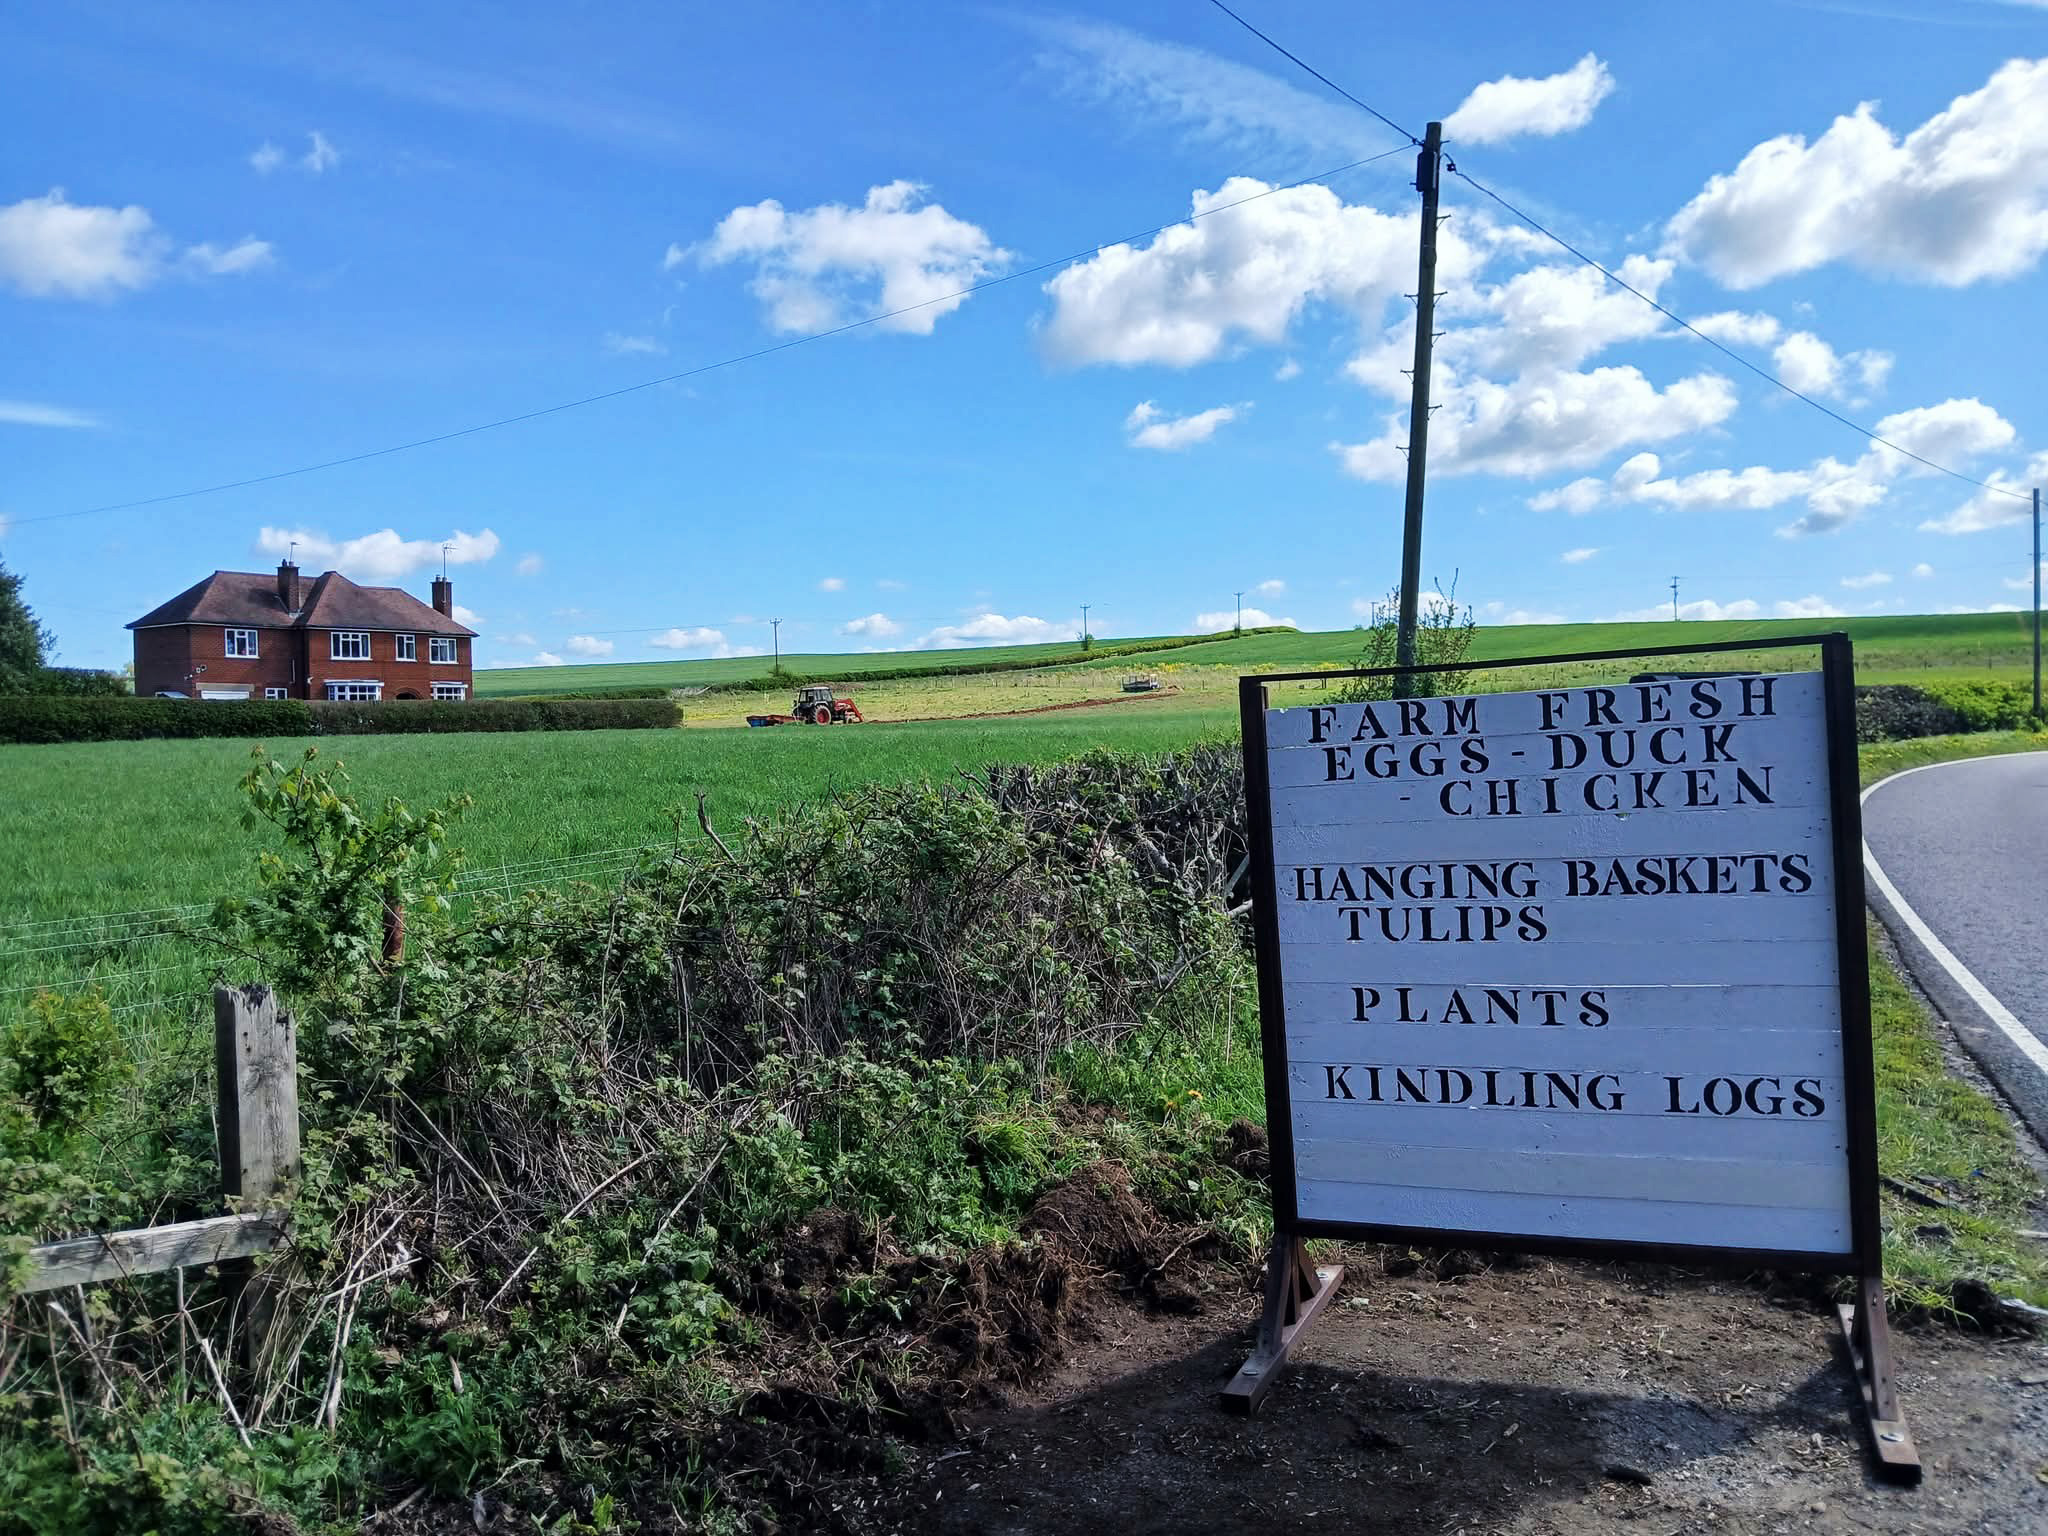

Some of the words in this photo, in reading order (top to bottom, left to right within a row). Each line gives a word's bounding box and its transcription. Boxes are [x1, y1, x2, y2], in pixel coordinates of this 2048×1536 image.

[1307, 696, 1481, 744] FARM
[1537, 677, 1777, 731] FRESH
[1323, 737, 1491, 782] EGGS
[1548, 724, 1737, 771] DUCK
[1439, 766, 1775, 816] CHICKEN
[1293, 861, 1540, 902] HANGING
[1562, 853, 1813, 898] BASKETS
[1337, 905, 1548, 943] TULIPS
[1350, 987, 1610, 1028] PLANTS
[1324, 1065, 1626, 1111] KINDLING
[1664, 1076, 1826, 1117] LOGS
